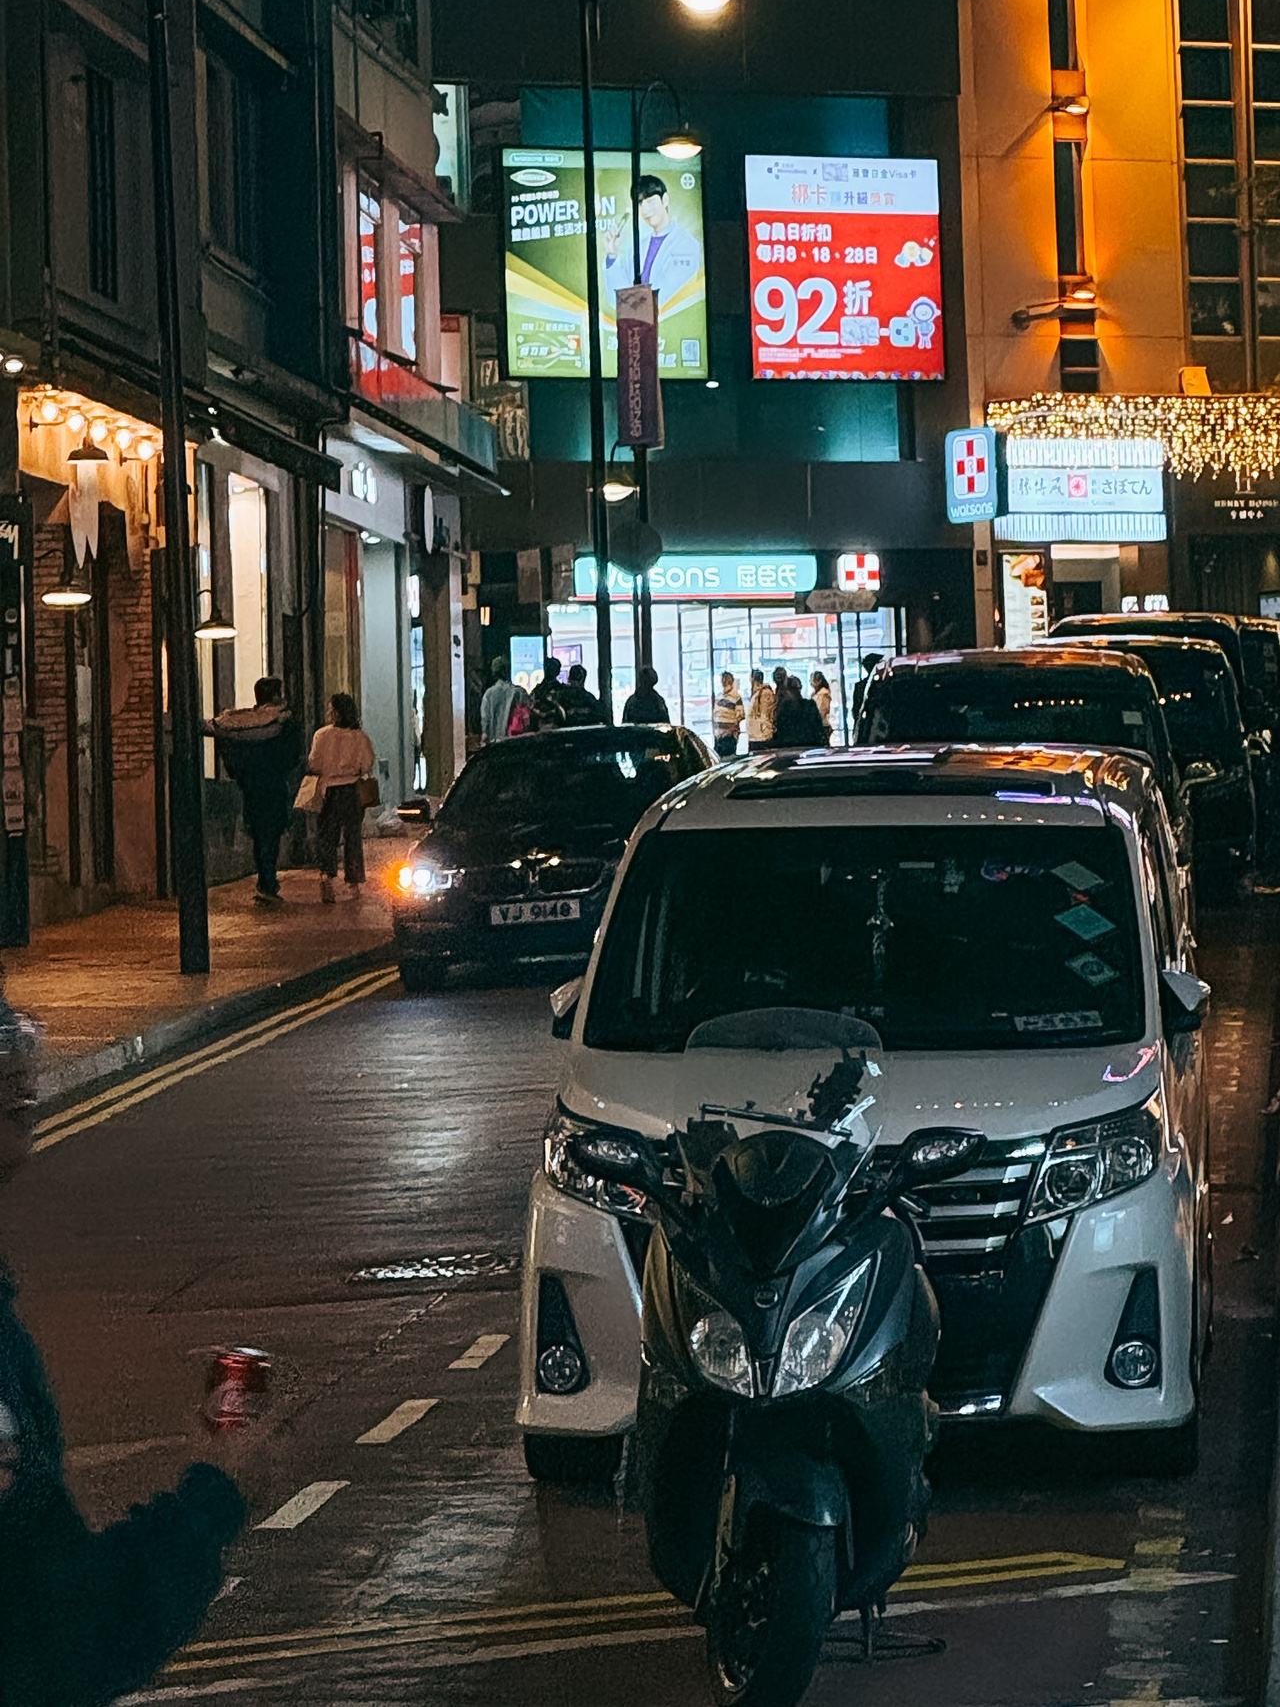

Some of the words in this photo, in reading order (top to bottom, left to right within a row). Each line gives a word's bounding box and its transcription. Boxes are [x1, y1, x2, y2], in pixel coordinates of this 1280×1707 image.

[513, 199, 580, 227] POWER
[755, 222, 832, 242] 會員日折扣
[1101, 478, 1153, 495] さぼてん
[950, 501, 994, 519] watsons
[589, 566, 720, 589] wasons
[737, 564, 797, 588] 屈臣氏
